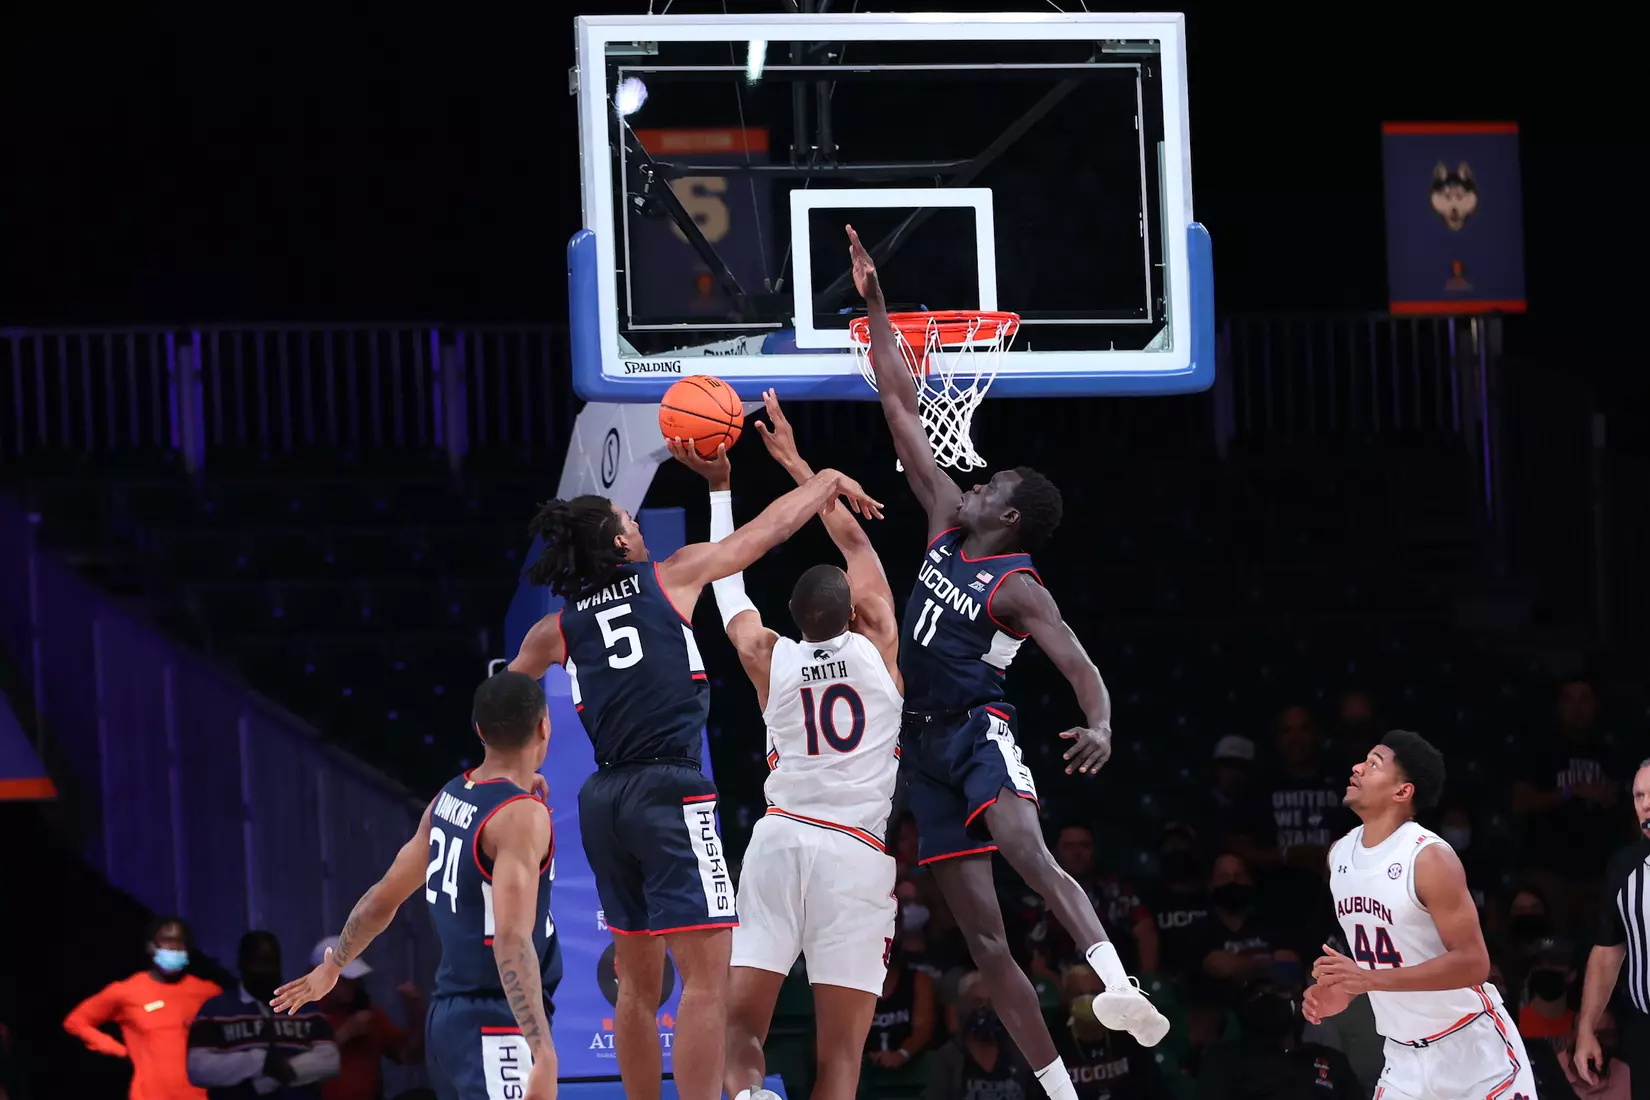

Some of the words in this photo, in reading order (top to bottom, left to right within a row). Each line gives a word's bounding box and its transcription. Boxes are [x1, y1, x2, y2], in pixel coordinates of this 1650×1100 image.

[624, 360, 681, 375] SPALDING
[576, 573, 641, 612] WHALEY
[918, 559, 982, 622] UCONN
[594, 603, 645, 670] 5
[912, 597, 944, 648] 11
[801, 660, 848, 682] SMITH
[799, 683, 866, 756] 10
[425, 826, 463, 914] 24
[696, 810, 729, 911] HUSKIES
[1337, 896, 1394, 926] AUBURN
[1354, 924, 1404, 970] 44
[498, 1046, 524, 1100] HUS
